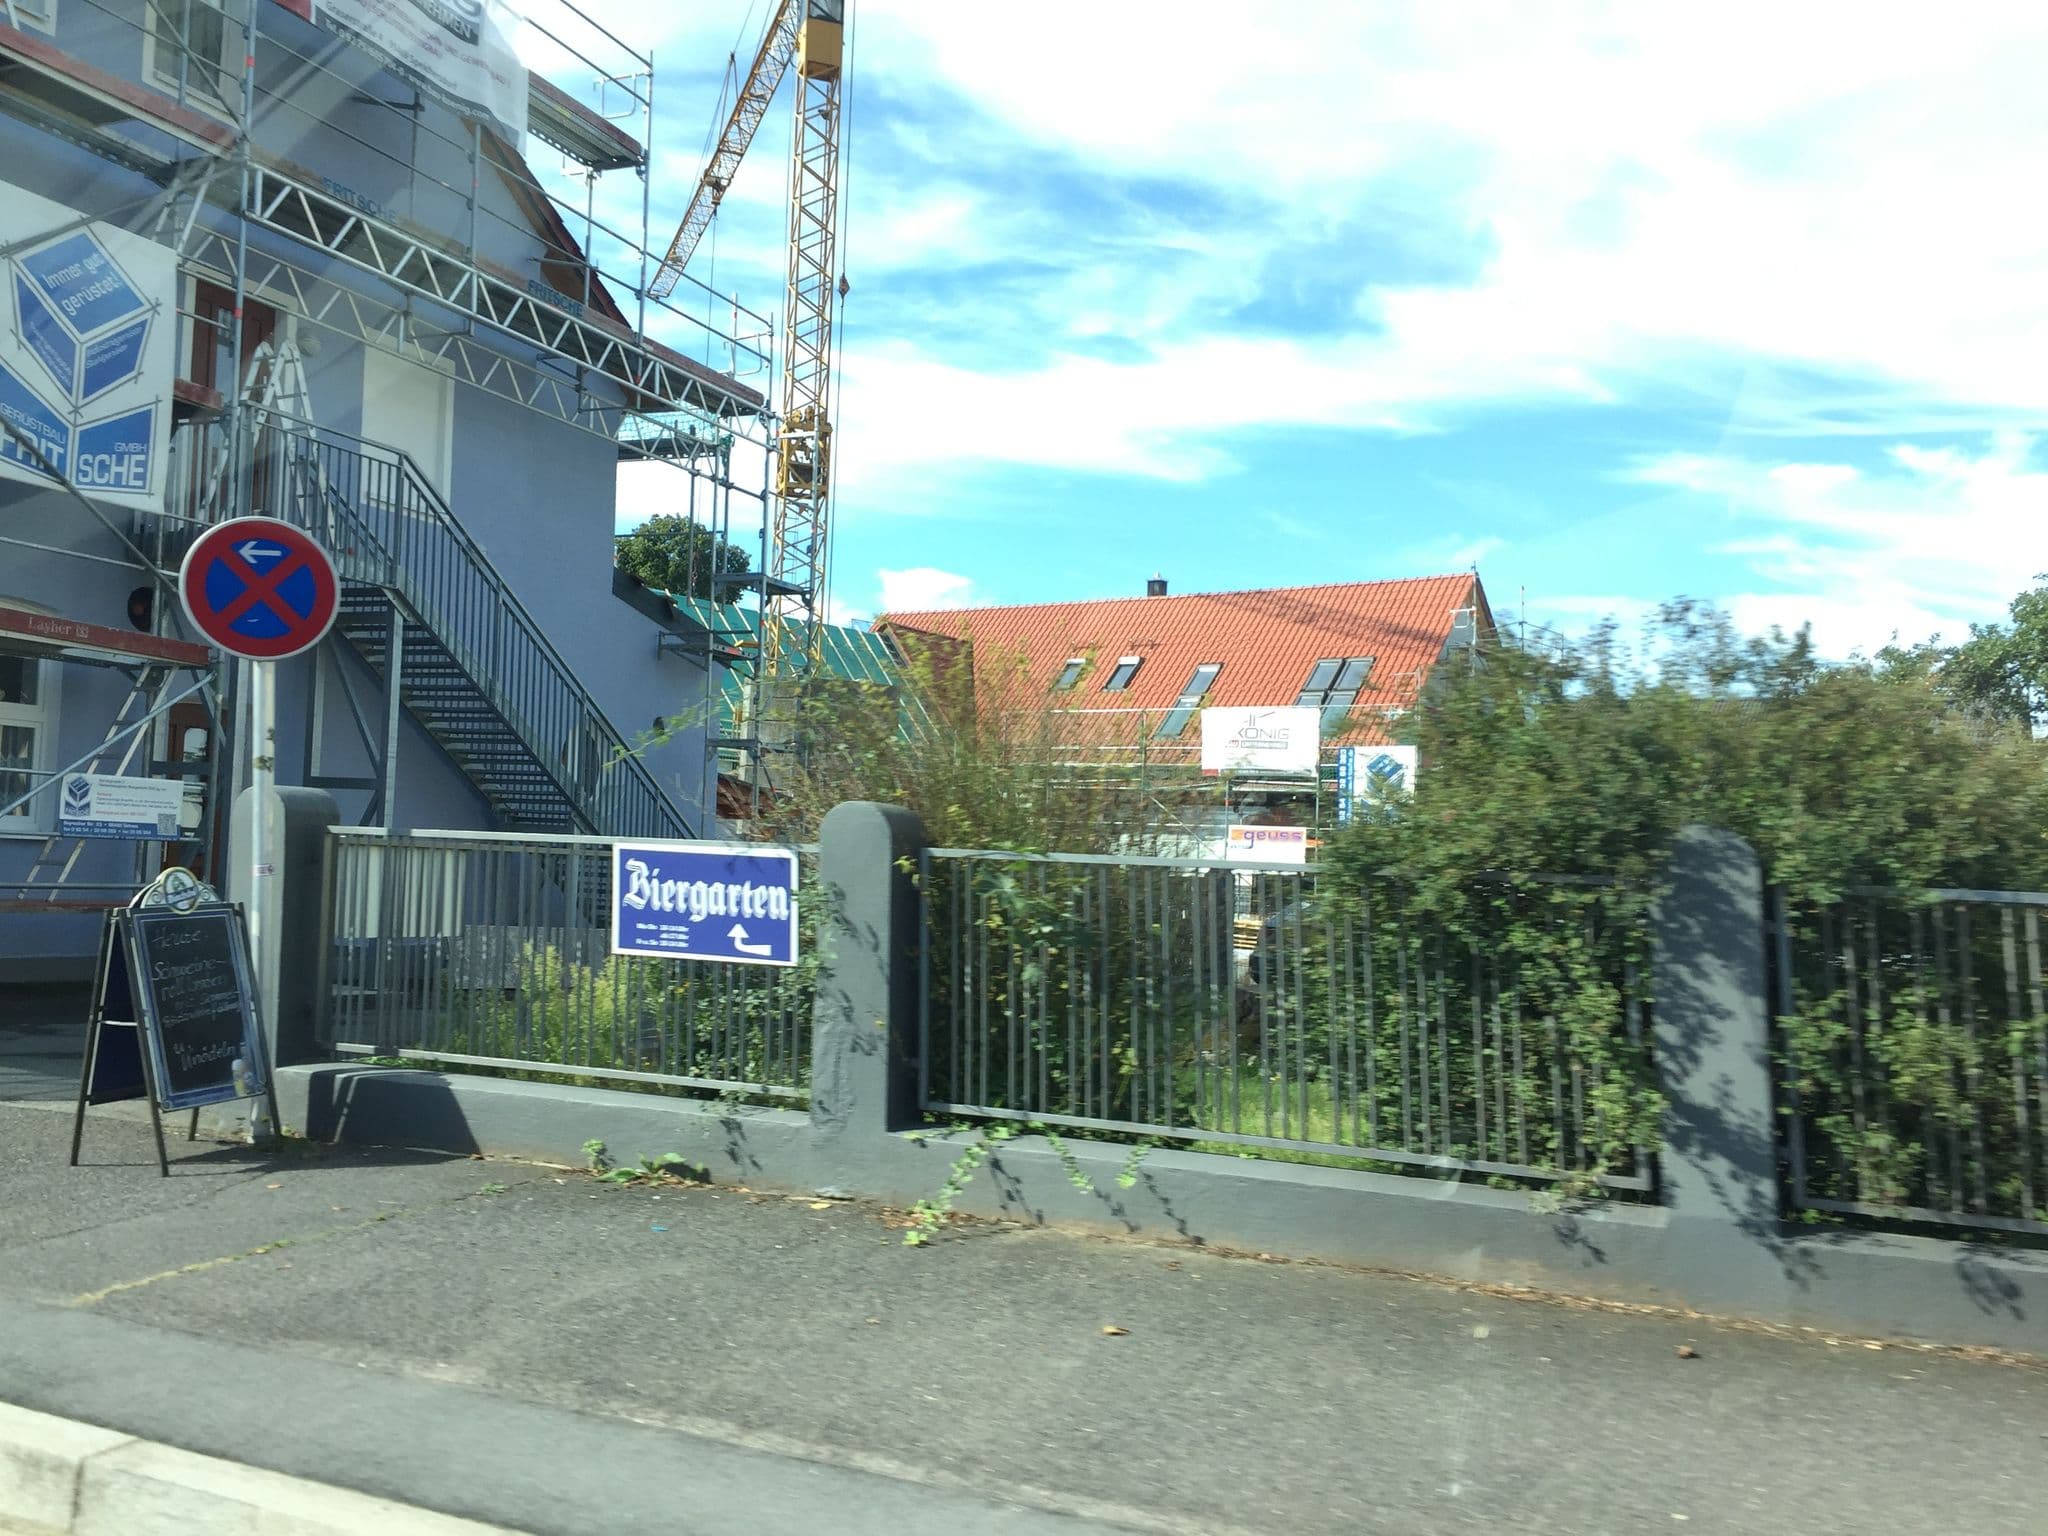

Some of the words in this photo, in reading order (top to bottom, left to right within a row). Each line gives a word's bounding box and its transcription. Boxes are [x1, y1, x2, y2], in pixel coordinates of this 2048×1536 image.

[41, 262, 82, 289] Immer
[527, 279, 583, 317] FRITSCHE
[114, 442, 147, 453] GMBH
[78, 453, 146, 486] SCHE
[1244, 831, 1303, 849] geuss
[622, 858, 790, 922] Biergarten
